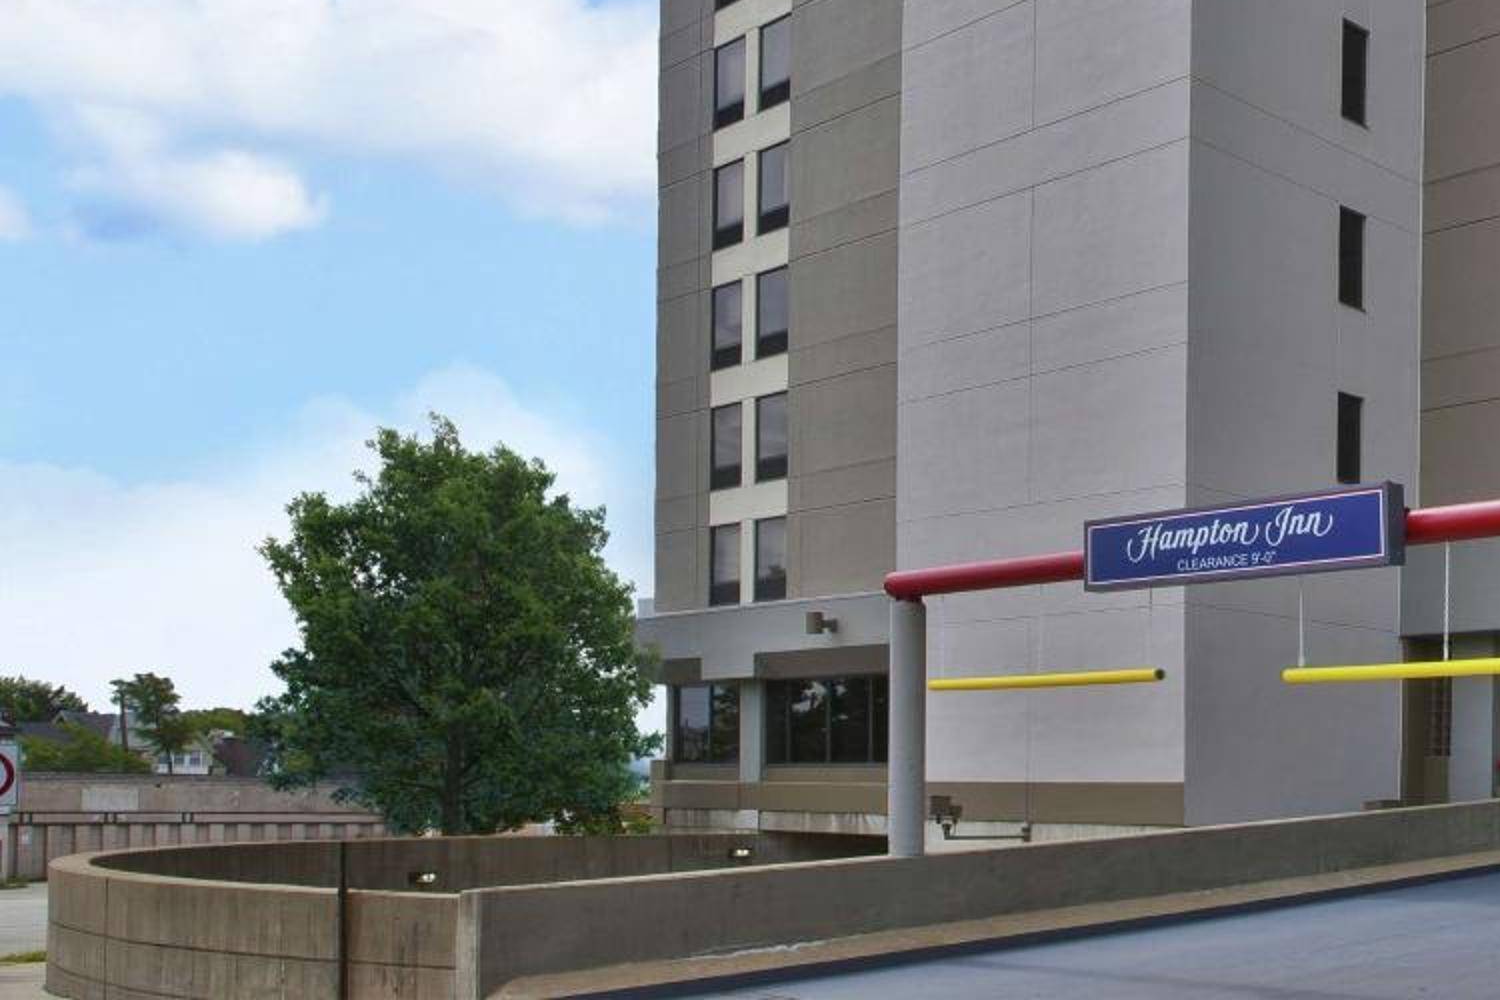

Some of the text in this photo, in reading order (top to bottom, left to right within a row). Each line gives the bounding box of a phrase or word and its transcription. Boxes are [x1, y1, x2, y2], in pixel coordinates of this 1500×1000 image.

[1127, 506, 1333, 563] Hampton Inn
[1177, 553, 1248, 571] CLEARANCE
